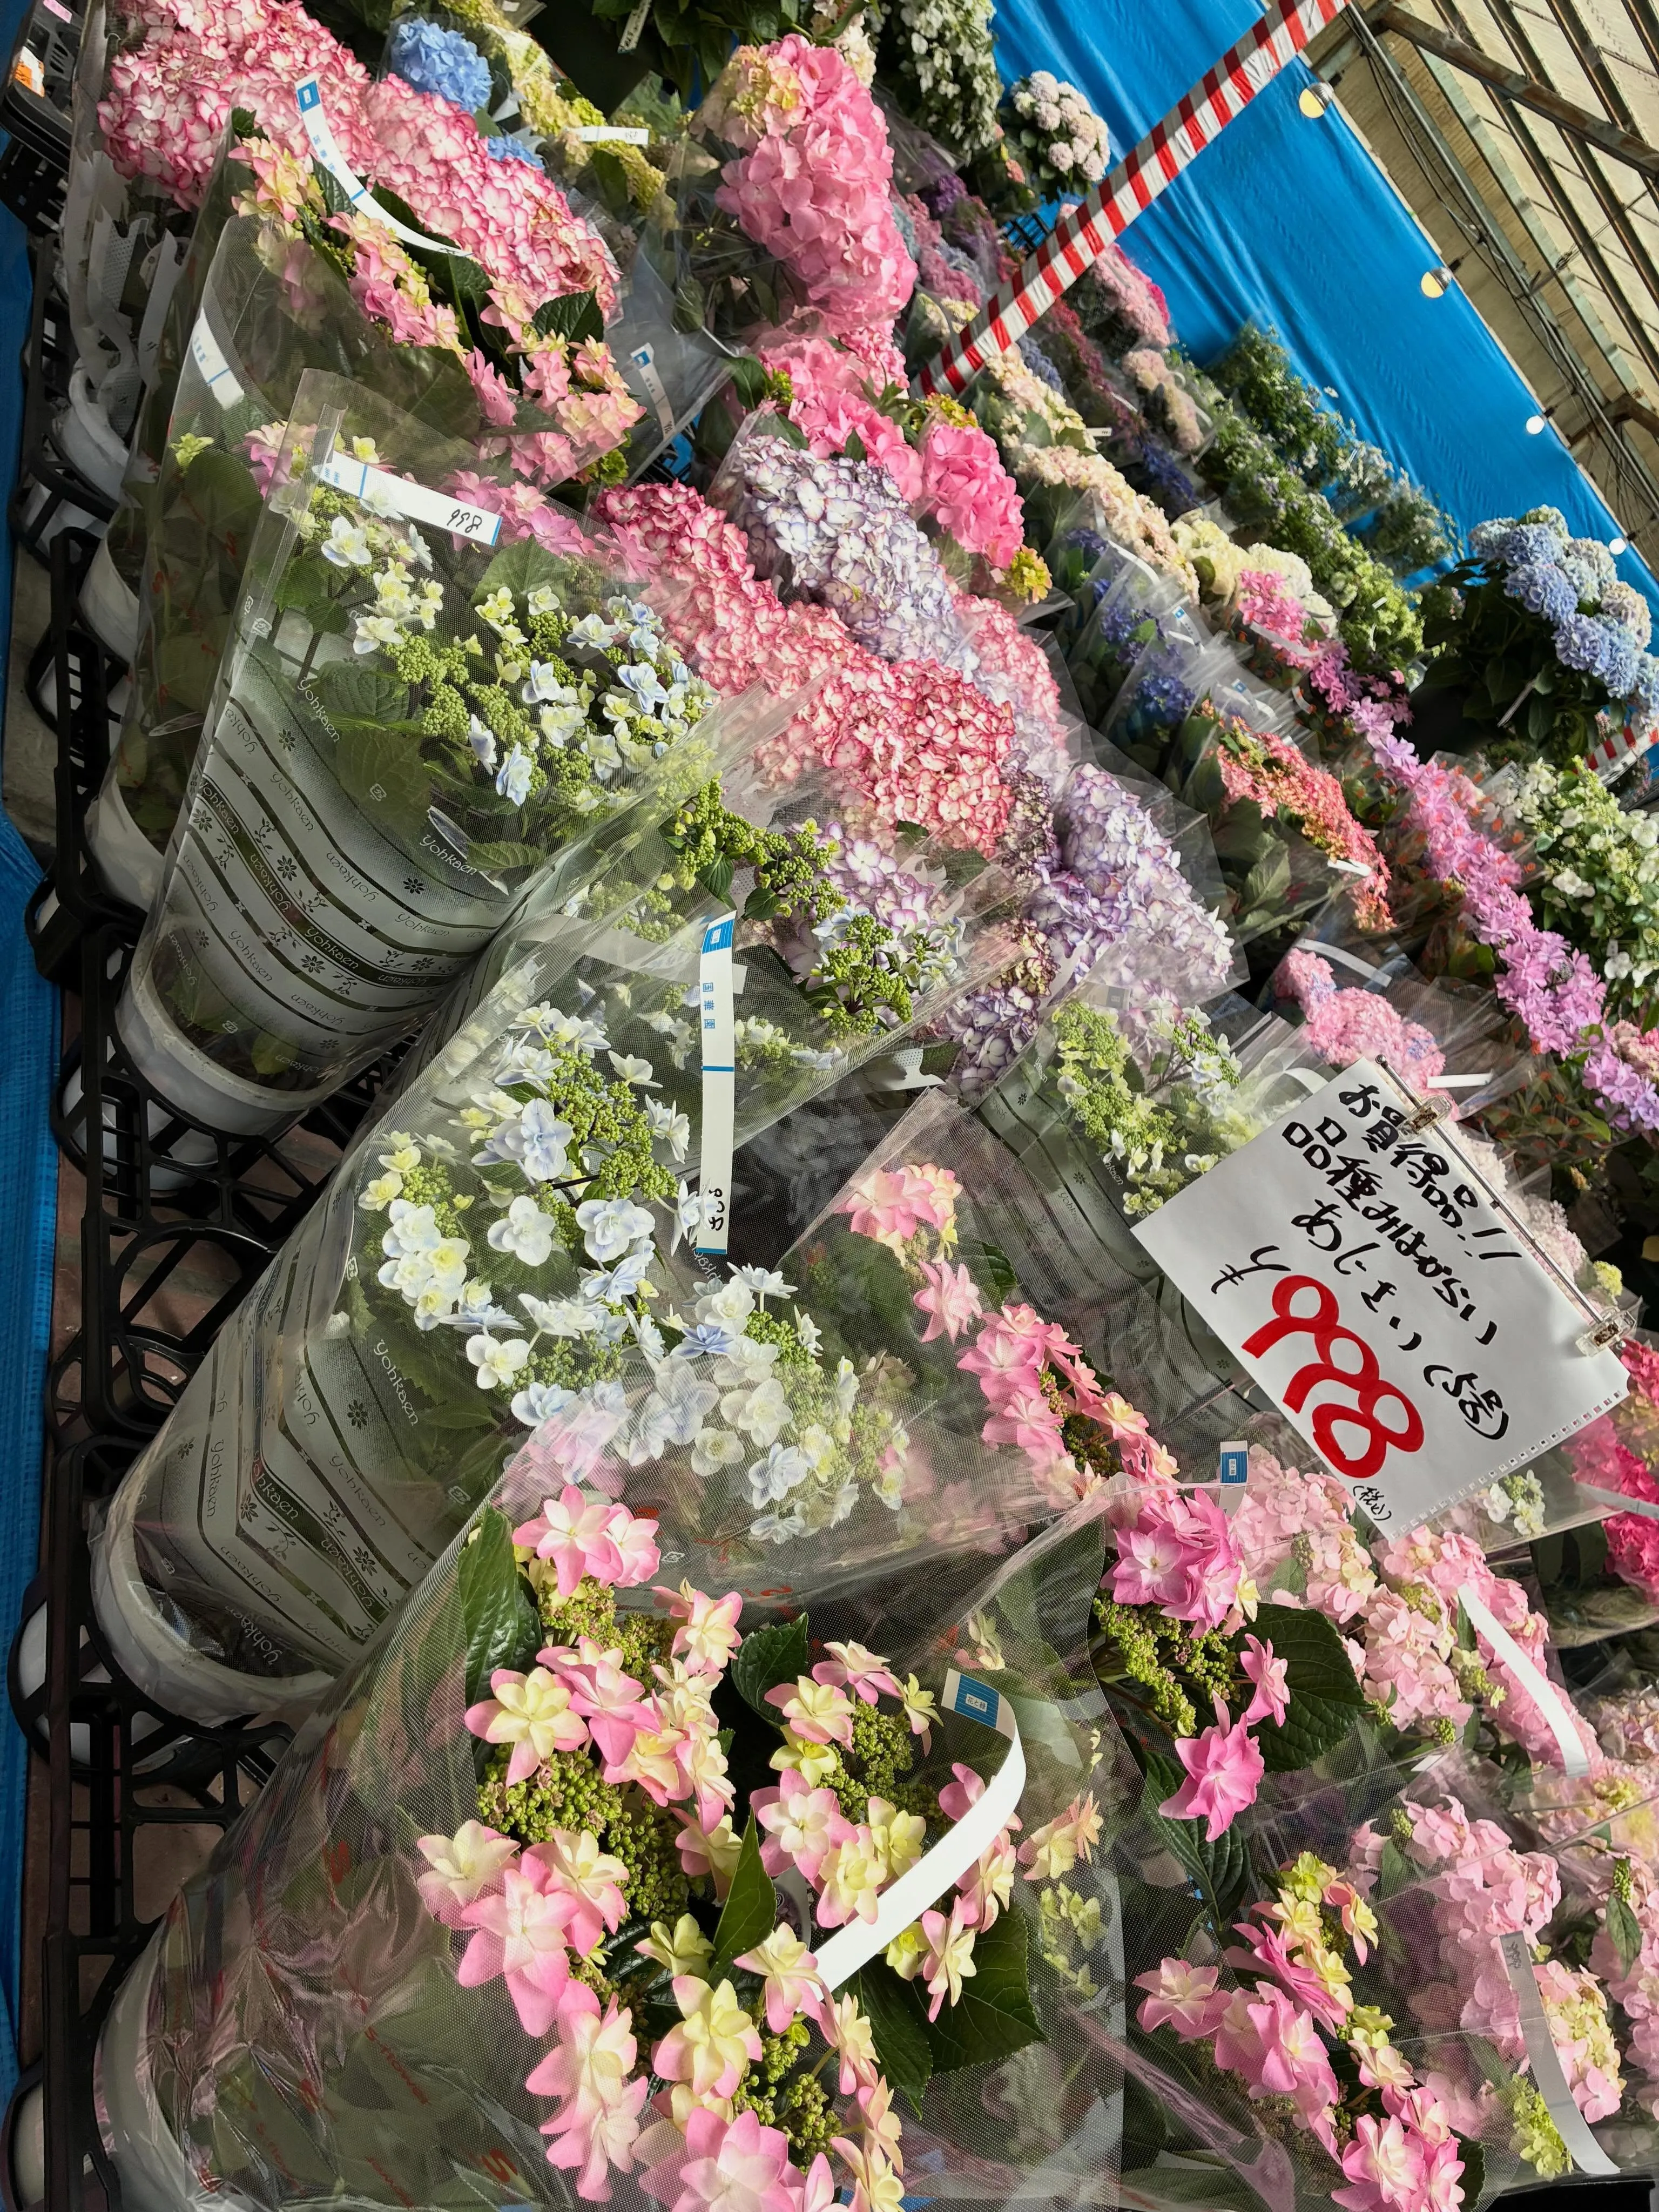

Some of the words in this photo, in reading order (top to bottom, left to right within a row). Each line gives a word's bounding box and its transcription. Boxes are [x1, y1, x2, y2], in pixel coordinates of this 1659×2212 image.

[225, 709, 258, 755] Yohka
[702, 982, 716, 1029] 国華園
